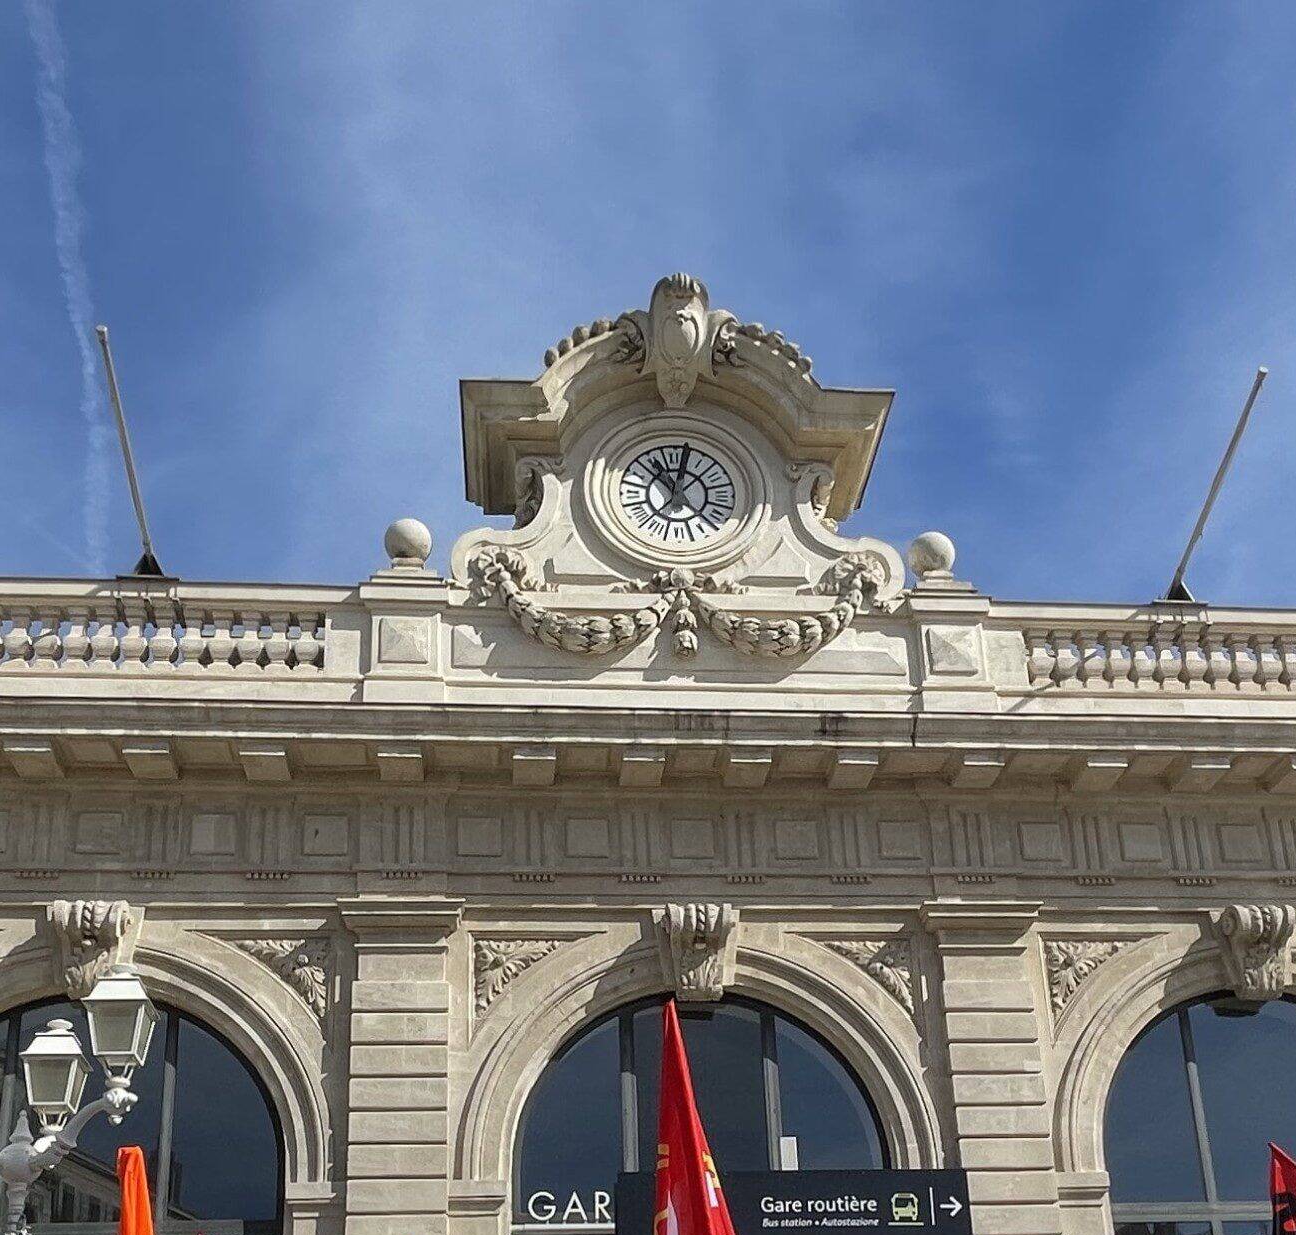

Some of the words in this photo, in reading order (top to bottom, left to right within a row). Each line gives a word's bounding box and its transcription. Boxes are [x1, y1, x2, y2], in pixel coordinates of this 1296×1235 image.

[528, 1191, 612, 1221] GAR
[761, 1197, 802, 1213] Gare
[807, 1195, 878, 1213] routière
[762, 1218, 779, 1227] Bus
[781, 1218, 812, 1227] station
[821, 1217, 879, 1227] Autostazione
